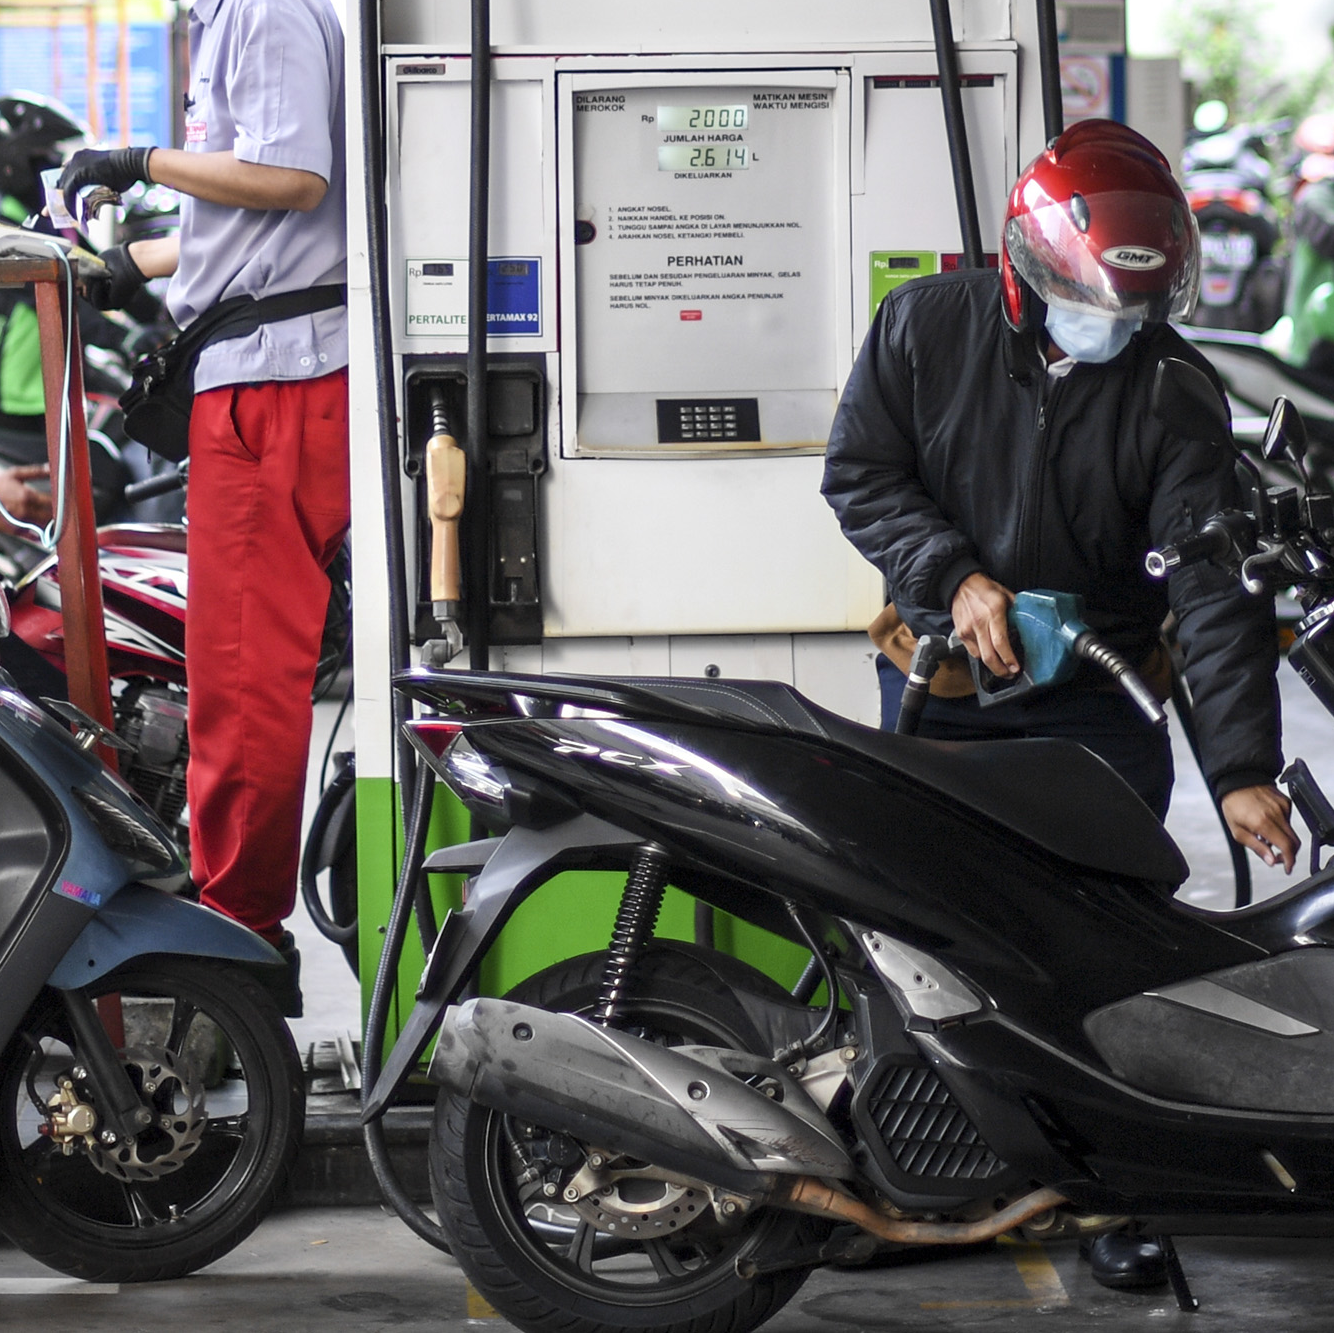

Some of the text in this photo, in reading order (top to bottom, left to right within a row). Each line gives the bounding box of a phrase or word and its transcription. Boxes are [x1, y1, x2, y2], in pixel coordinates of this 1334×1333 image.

[576, 95, 626, 103] DILARANG
[753, 93, 828, 101] MATIKAN MESIN
[576, 104, 625, 112] MEROKOK
[753, 101, 830, 110] WAKTU MENGISI
[641, 115, 654, 124] Rp
[689, 109, 745, 128] 2000
[663, 134, 744, 143] JUMLAH HARGA
[667, 255, 743, 266] PERHATIAN
[1117, 251, 1158, 263] GMT
[409, 315, 466, 324] PERTALITE
[486, 313, 538, 322] ERTAMAX 92
[554, 738, 692, 776] PCX
